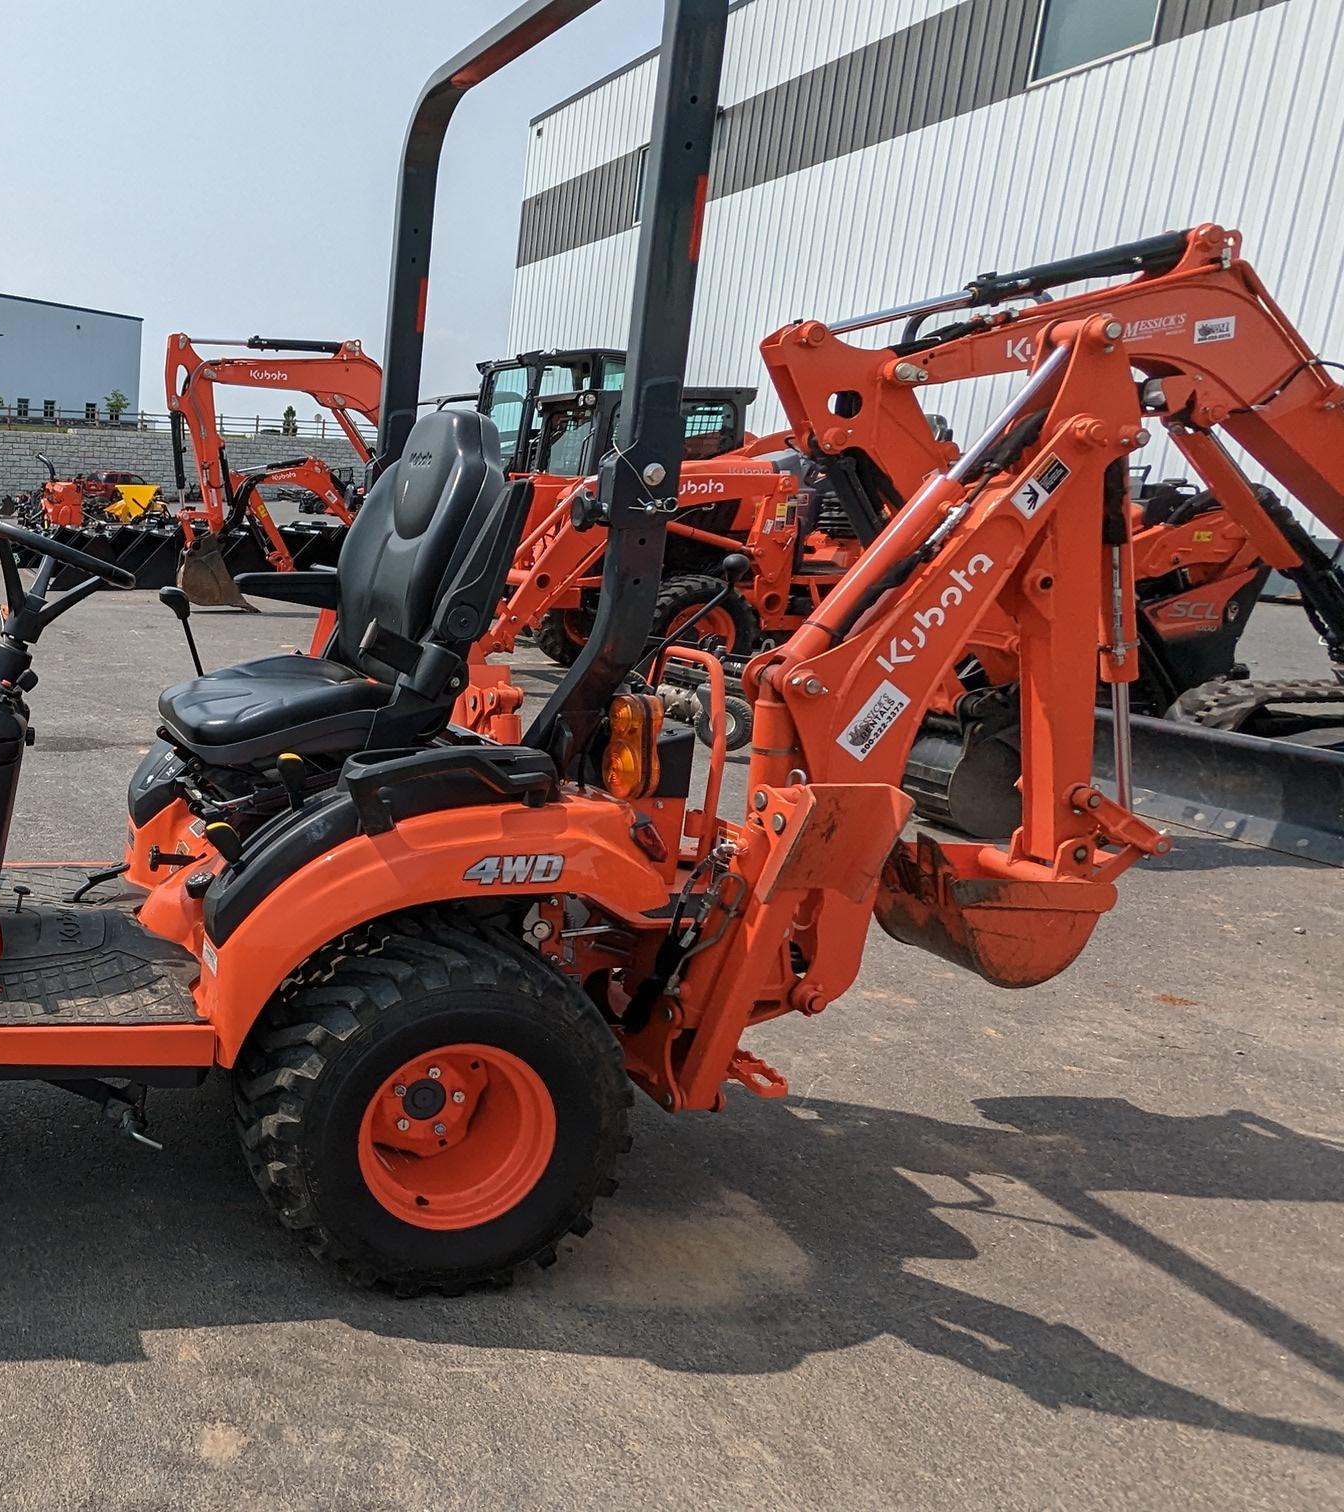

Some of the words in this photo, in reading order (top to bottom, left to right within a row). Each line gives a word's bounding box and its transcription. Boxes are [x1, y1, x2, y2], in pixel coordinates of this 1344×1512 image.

[1123, 313, 1187, 338] MESSICK'S
[249, 369, 288, 381] Kubota
[271, 472, 296, 481] Kubota
[679, 479, 725, 495] ubota
[876, 553, 994, 673] Kubota
[1167, 601, 1220, 620] SCL
[861, 698, 896, 740] RENTALS
[463, 853, 565, 885] 4WD
